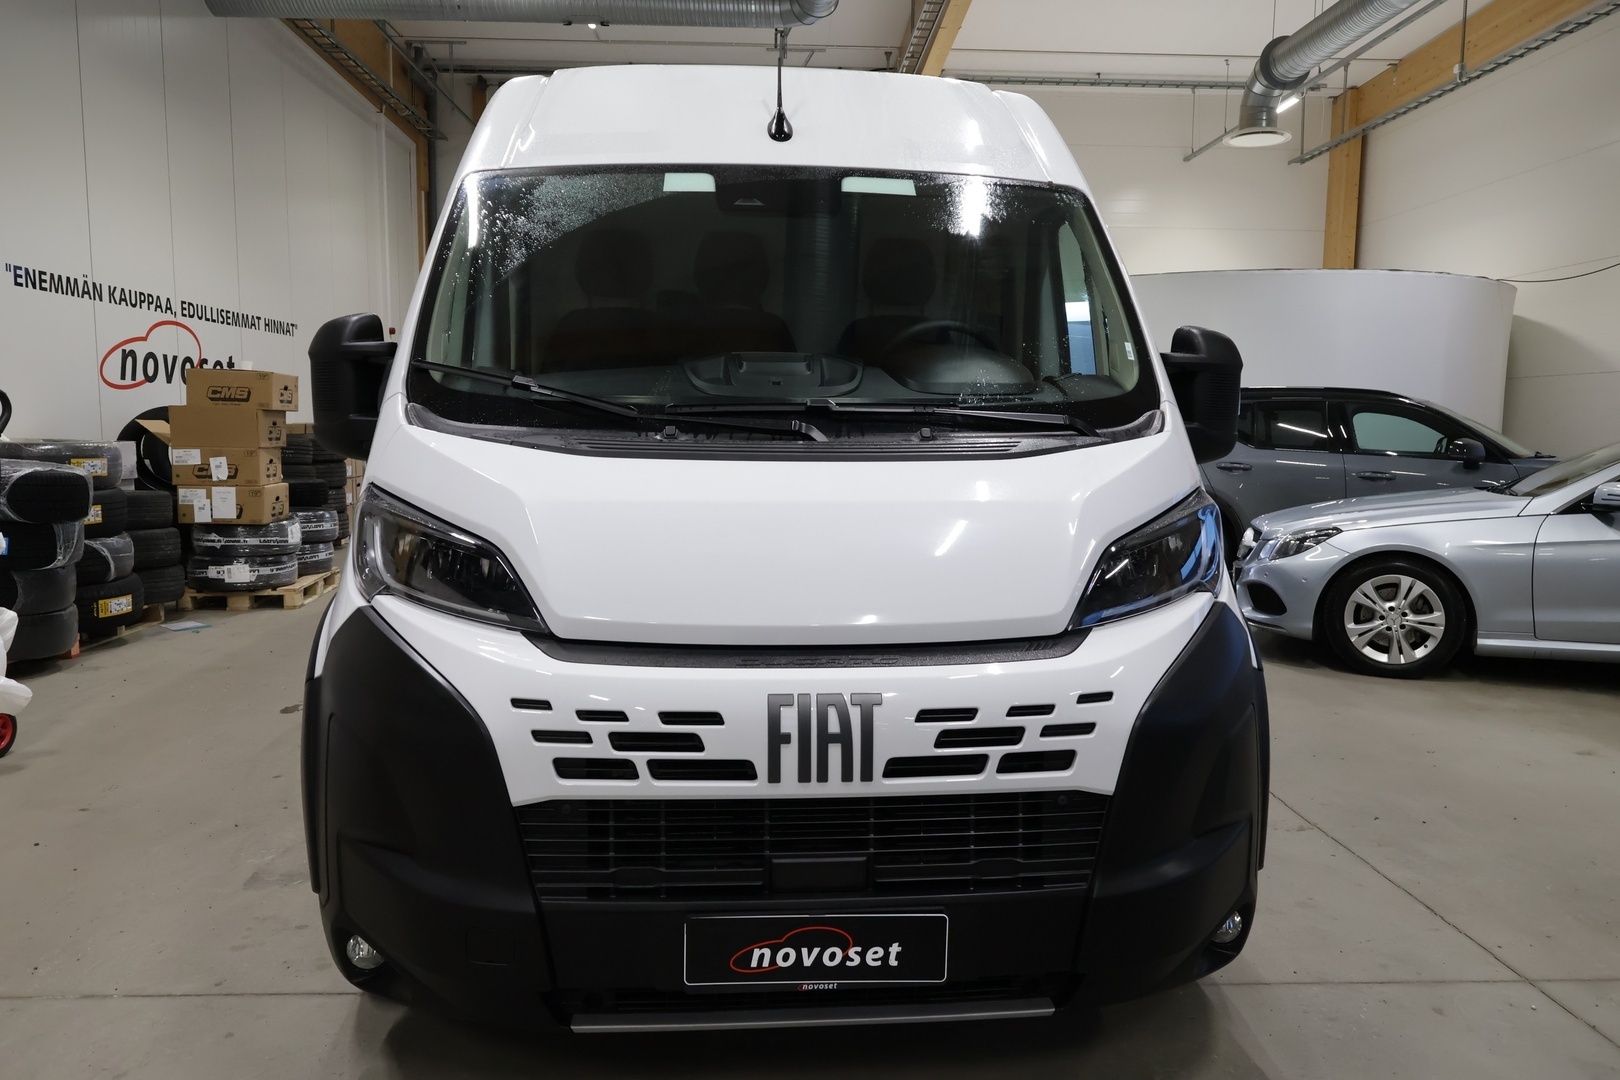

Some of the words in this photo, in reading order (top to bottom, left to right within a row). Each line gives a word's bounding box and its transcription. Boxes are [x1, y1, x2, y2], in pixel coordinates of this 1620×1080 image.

[5, 263, 103, 302] "ENEMMÄN
[108, 285, 177, 318] KAUPPAA,
[181, 300, 262, 331] EDULLISEMMAT
[207, 386, 251, 402] CMS
[767, 692, 883, 784] FIAT
[750, 942, 902, 968] novoset
[802, 982, 838, 990] novoset
